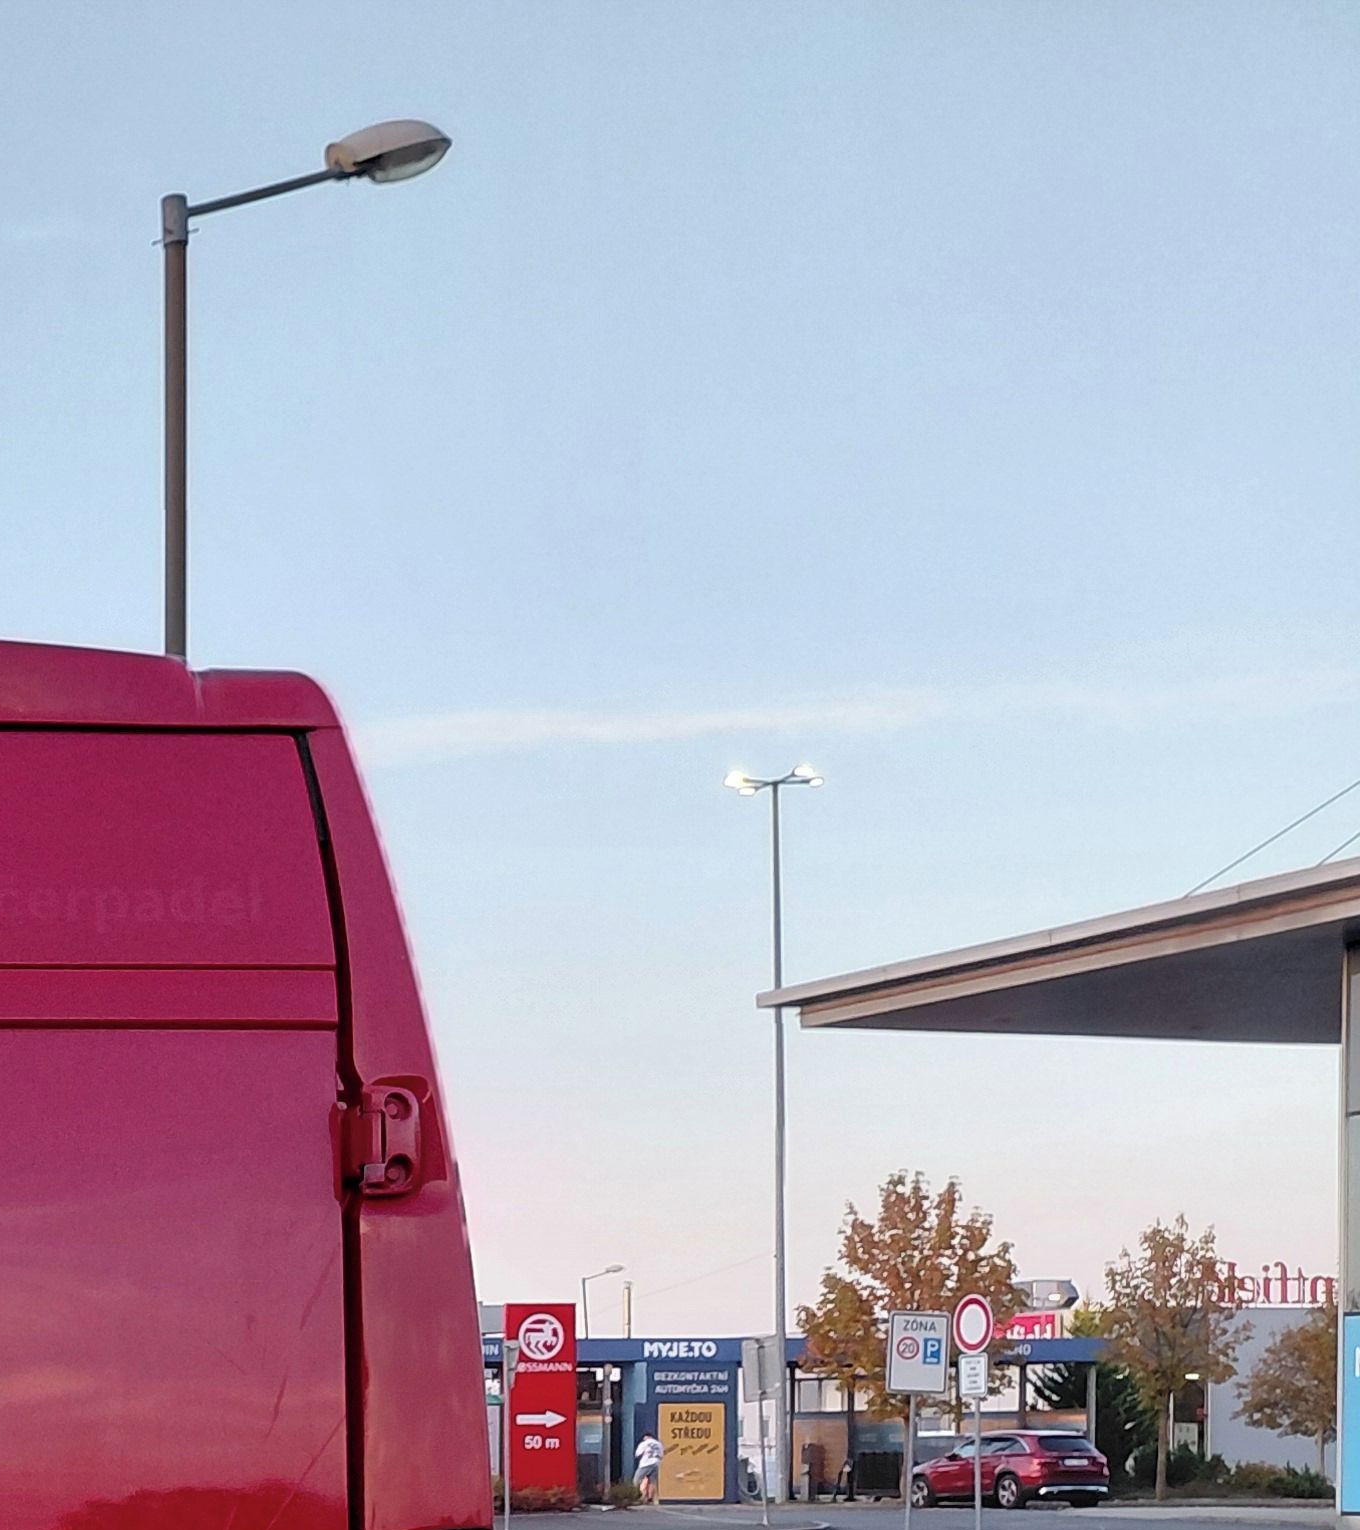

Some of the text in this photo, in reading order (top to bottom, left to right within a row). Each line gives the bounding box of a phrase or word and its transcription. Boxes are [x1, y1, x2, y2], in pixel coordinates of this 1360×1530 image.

[902, 1319, 936, 1333] ZÓNA
[644, 1341, 717, 1358] MYJE.TO
[901, 1343, 915, 1353] 20
[670, 1410, 712, 1423] KAŽDOU
[671, 1426, 711, 1439] STŘEDU
[524, 1435, 560, 1449] 50 m
